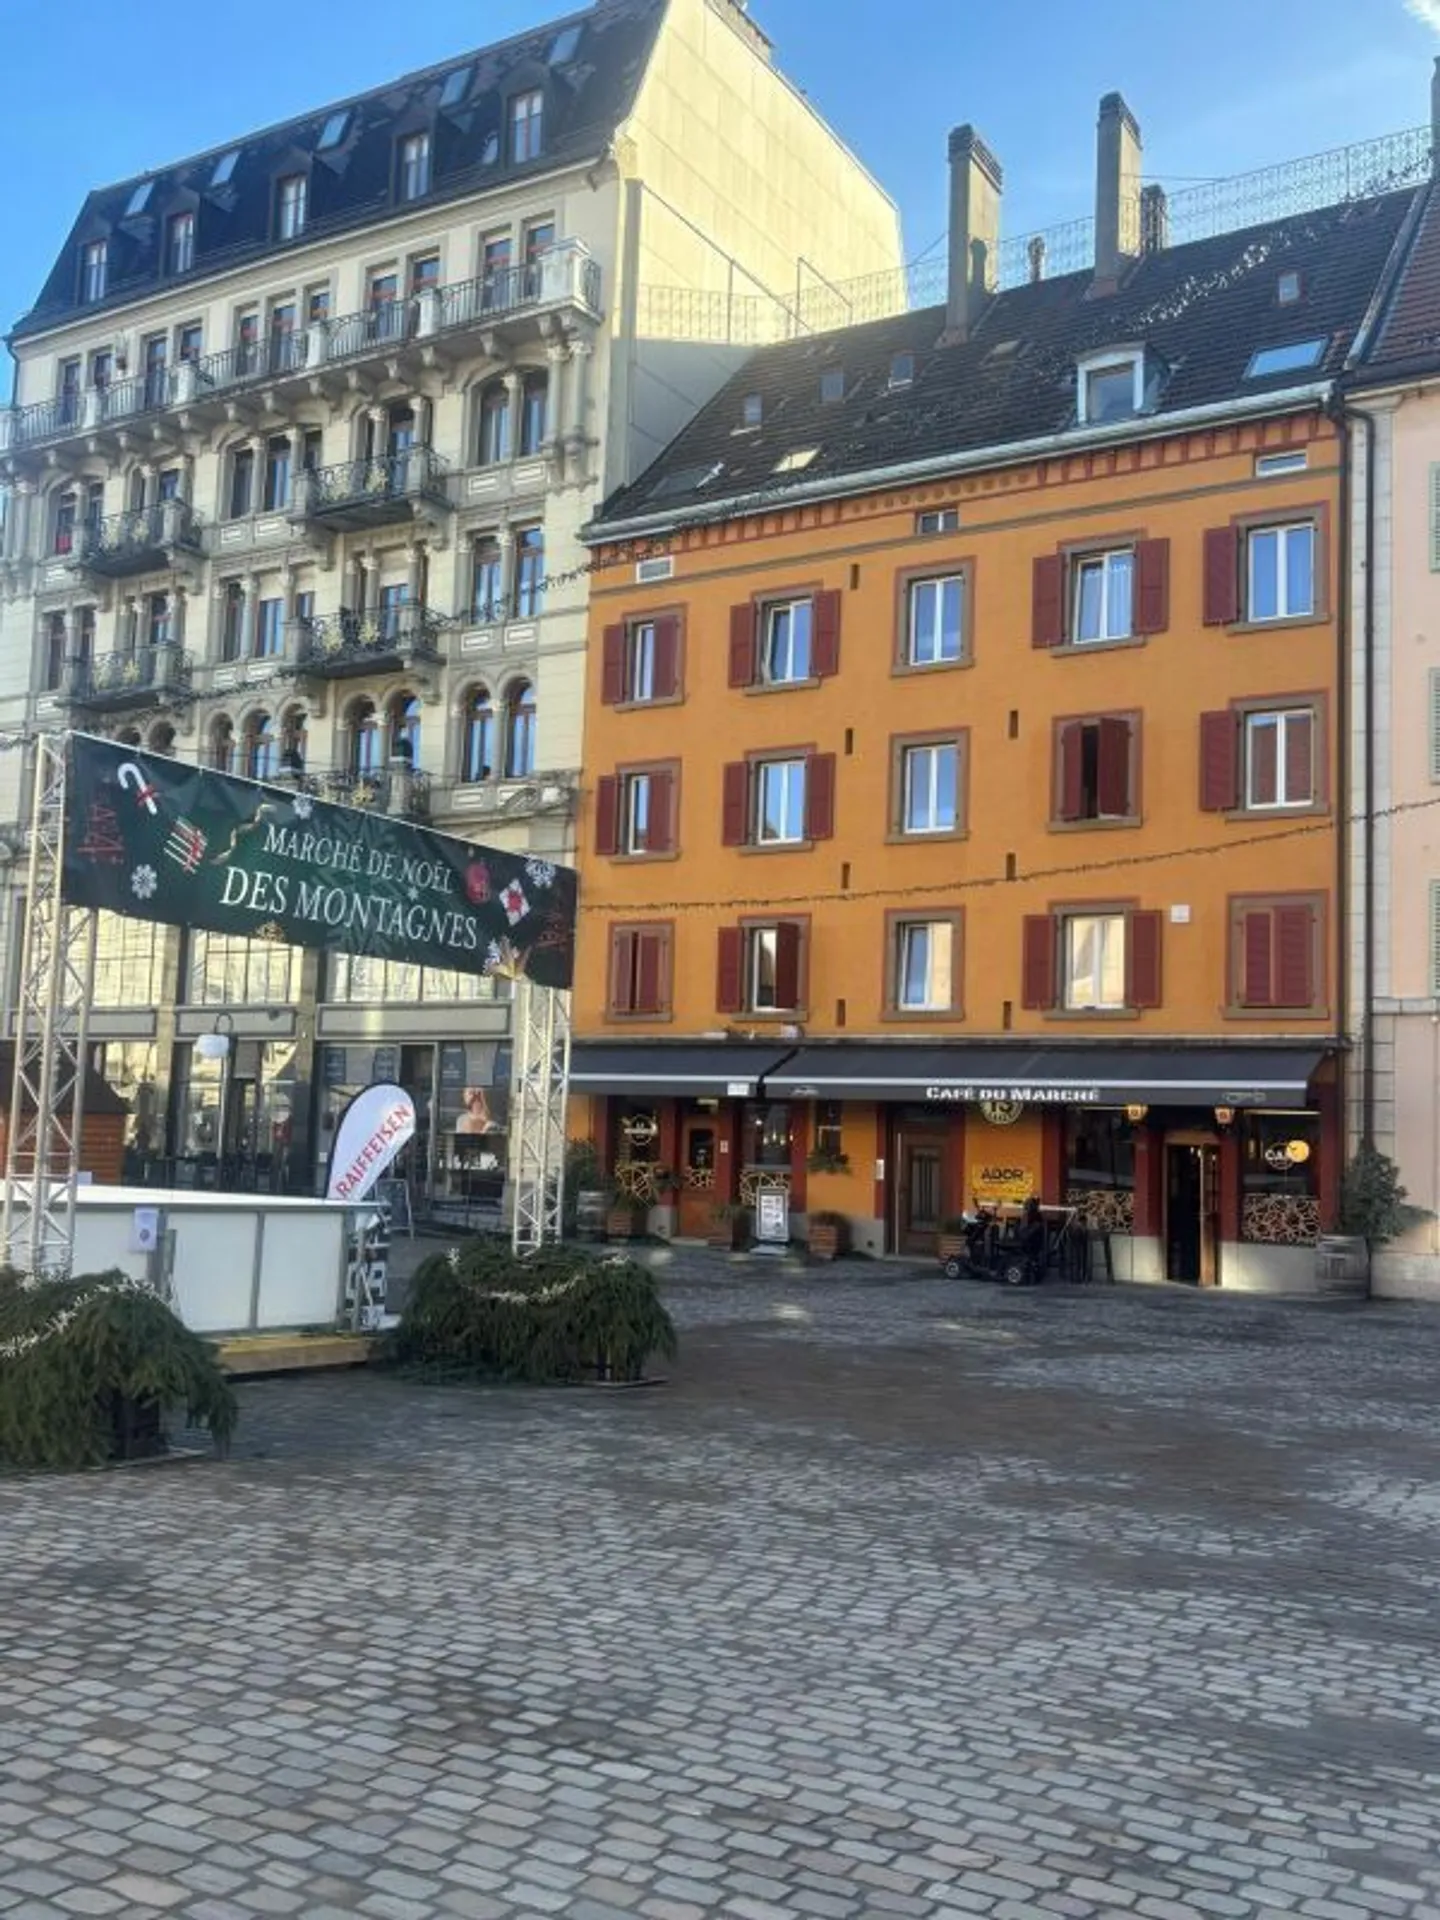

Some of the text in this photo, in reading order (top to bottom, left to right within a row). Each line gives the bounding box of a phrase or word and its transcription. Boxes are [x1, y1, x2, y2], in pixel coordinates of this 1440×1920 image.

[262, 823, 453, 894] MARCHÉ DE NOËL
[219, 866, 477, 949] DES MONTAGNES
[925, 1086, 1100, 1101] CAFÉ DU MARCHÉ
[335, 1104, 411, 1199] RAIFFEISEN
